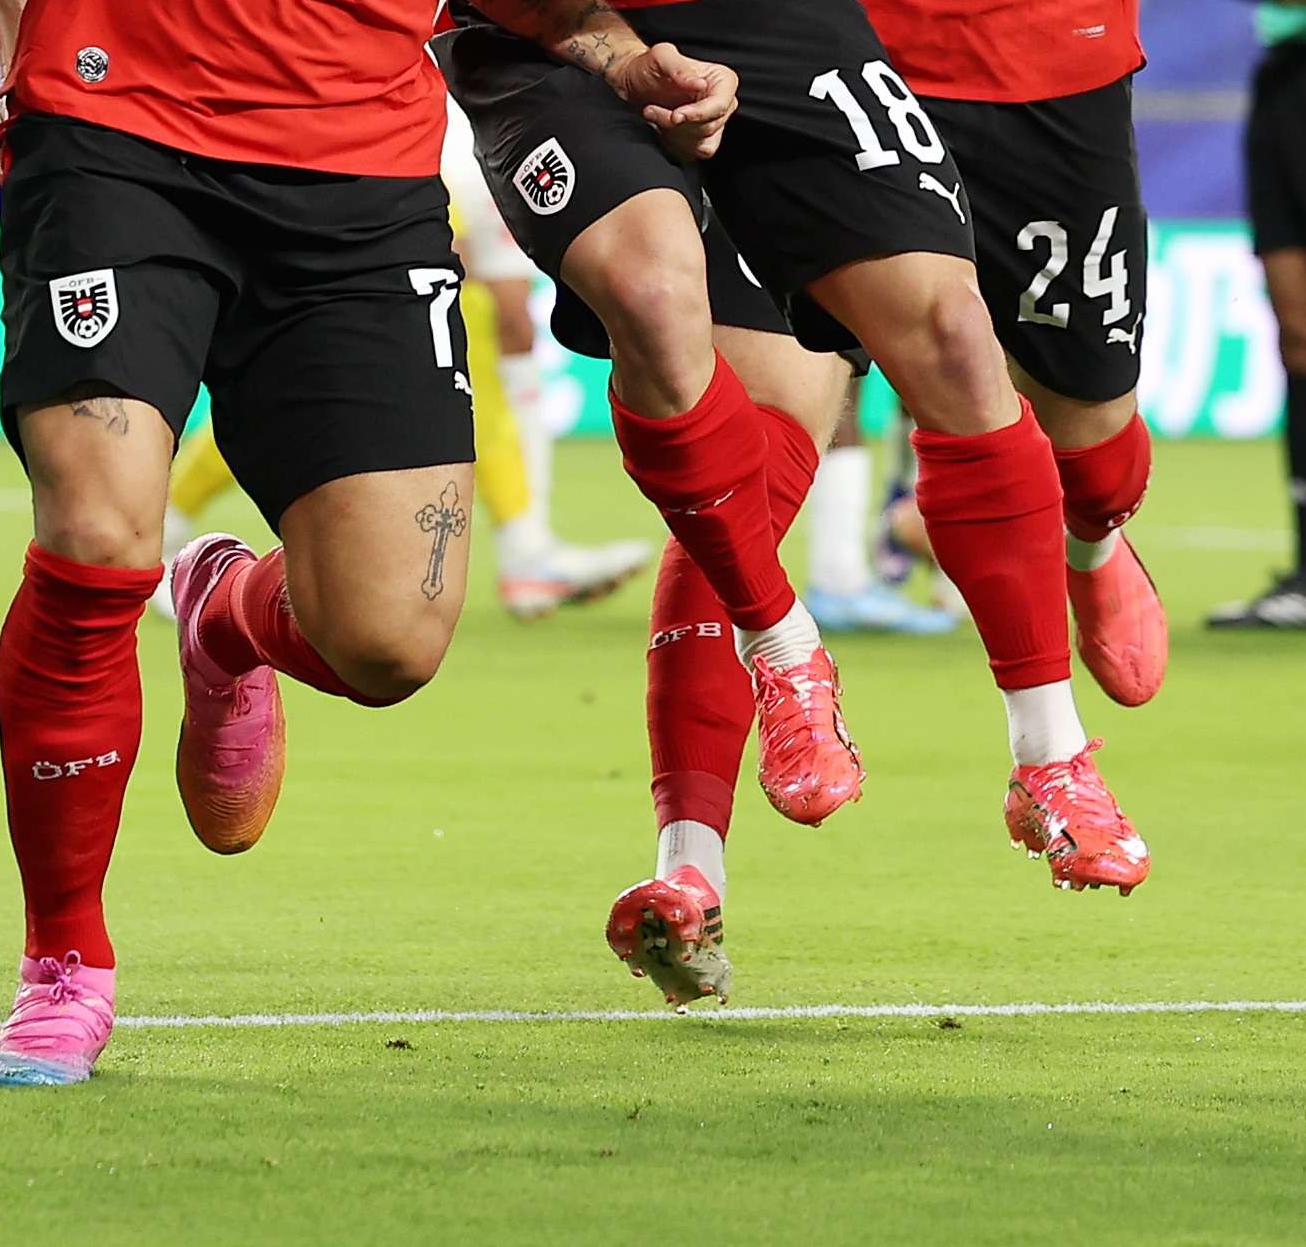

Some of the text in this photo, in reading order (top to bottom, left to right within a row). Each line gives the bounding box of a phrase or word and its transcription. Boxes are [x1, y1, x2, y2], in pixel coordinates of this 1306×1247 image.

[808, 59, 947, 172] 18
[408, 267, 462, 369] 7
[1016, 206, 1132, 330] 24
[31, 749, 123, 782] ÖFB
